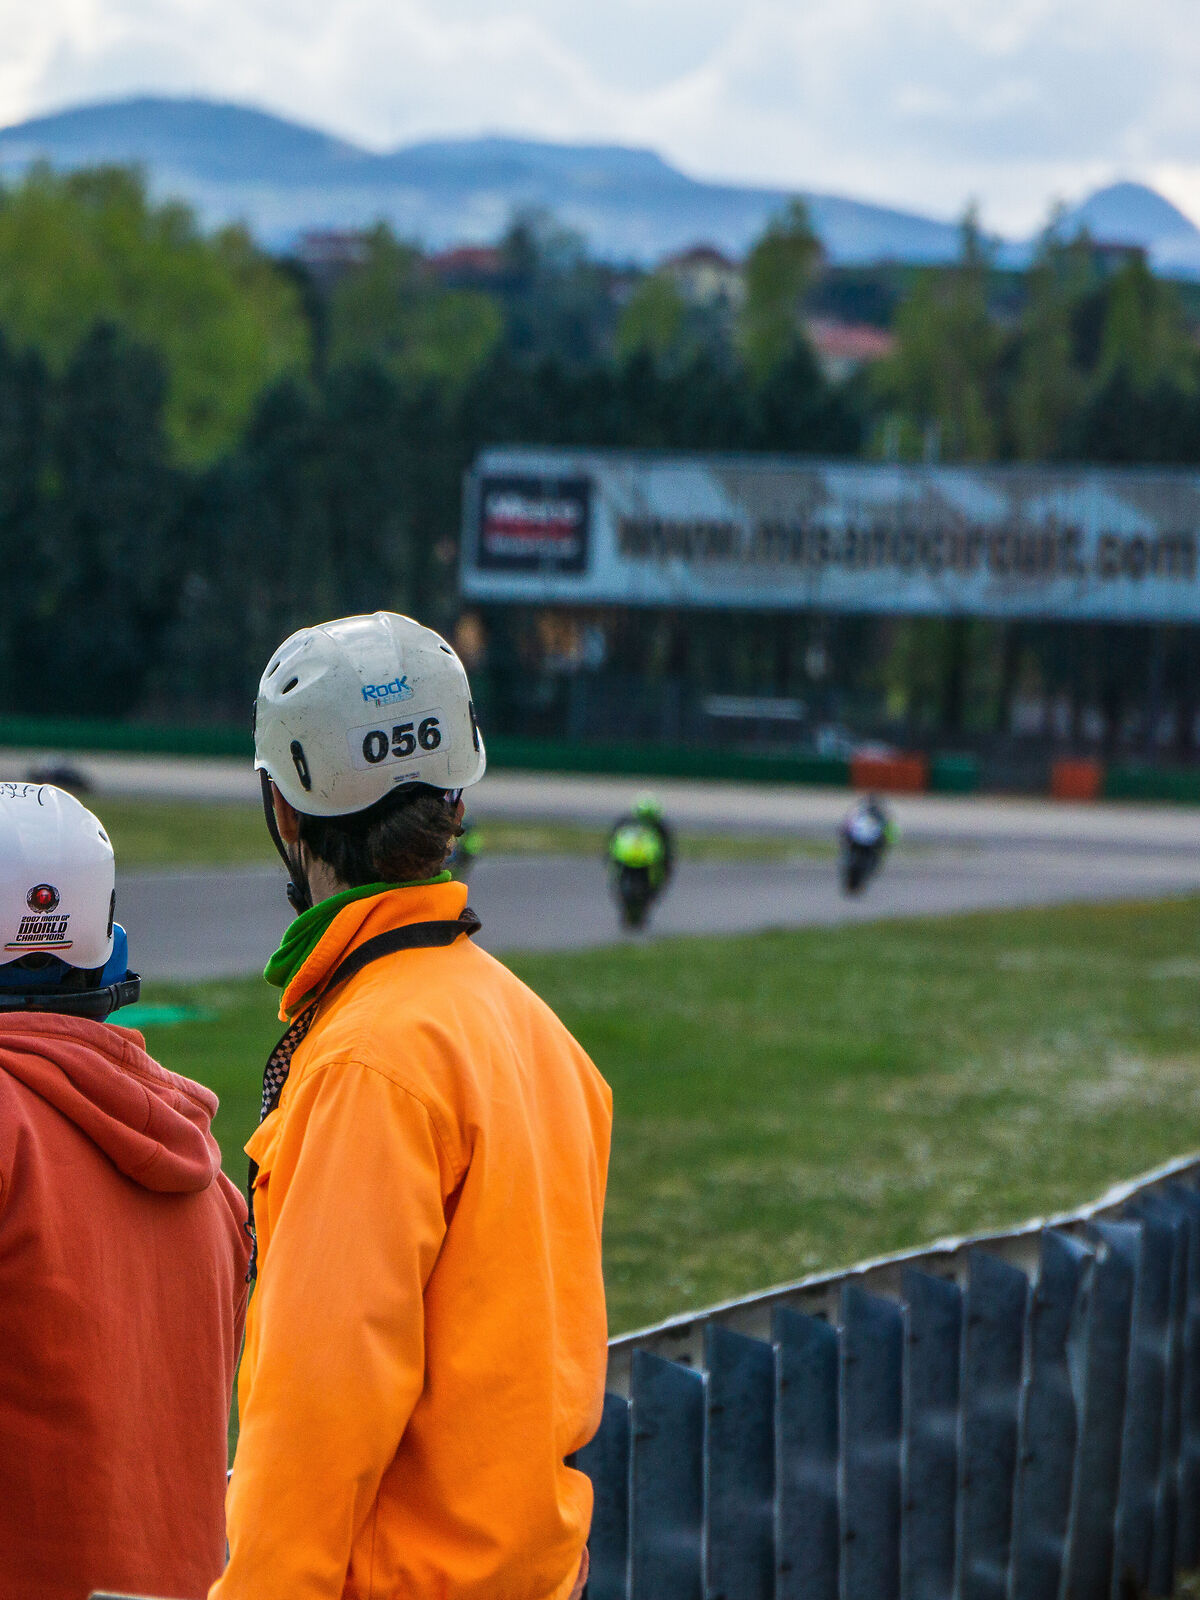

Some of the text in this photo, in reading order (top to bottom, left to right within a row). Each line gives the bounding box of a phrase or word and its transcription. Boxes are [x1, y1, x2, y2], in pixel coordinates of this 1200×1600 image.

[362, 717, 441, 764] 056
[18, 922, 68, 934] WORLD
[16, 933, 65, 941] CHAMPIONS
